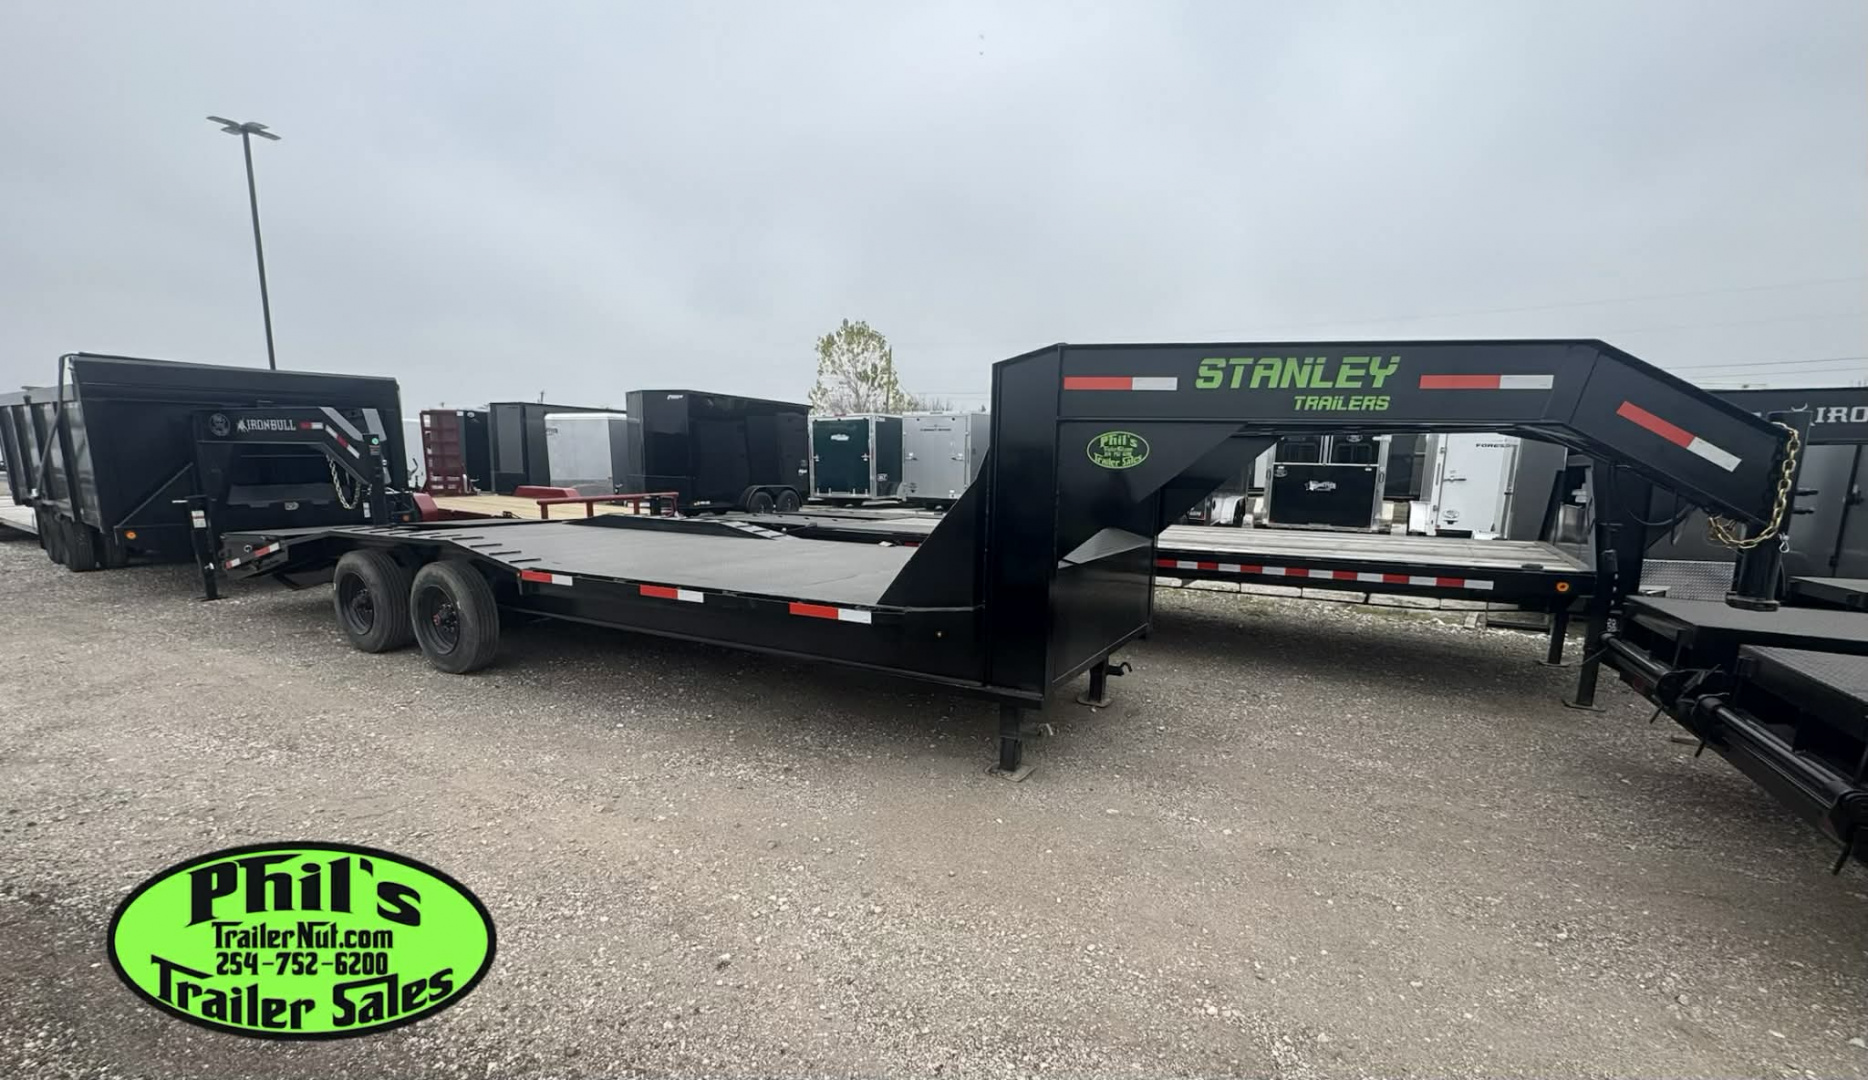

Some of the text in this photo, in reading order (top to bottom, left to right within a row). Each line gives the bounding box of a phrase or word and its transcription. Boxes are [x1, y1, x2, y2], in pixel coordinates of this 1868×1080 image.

[1195, 356, 1401, 389] STANLEY
[1294, 396, 1391, 411] TRAILERS
[247, 419, 296, 431] IRONBULL
[1100, 434, 1138, 448] Phil's
